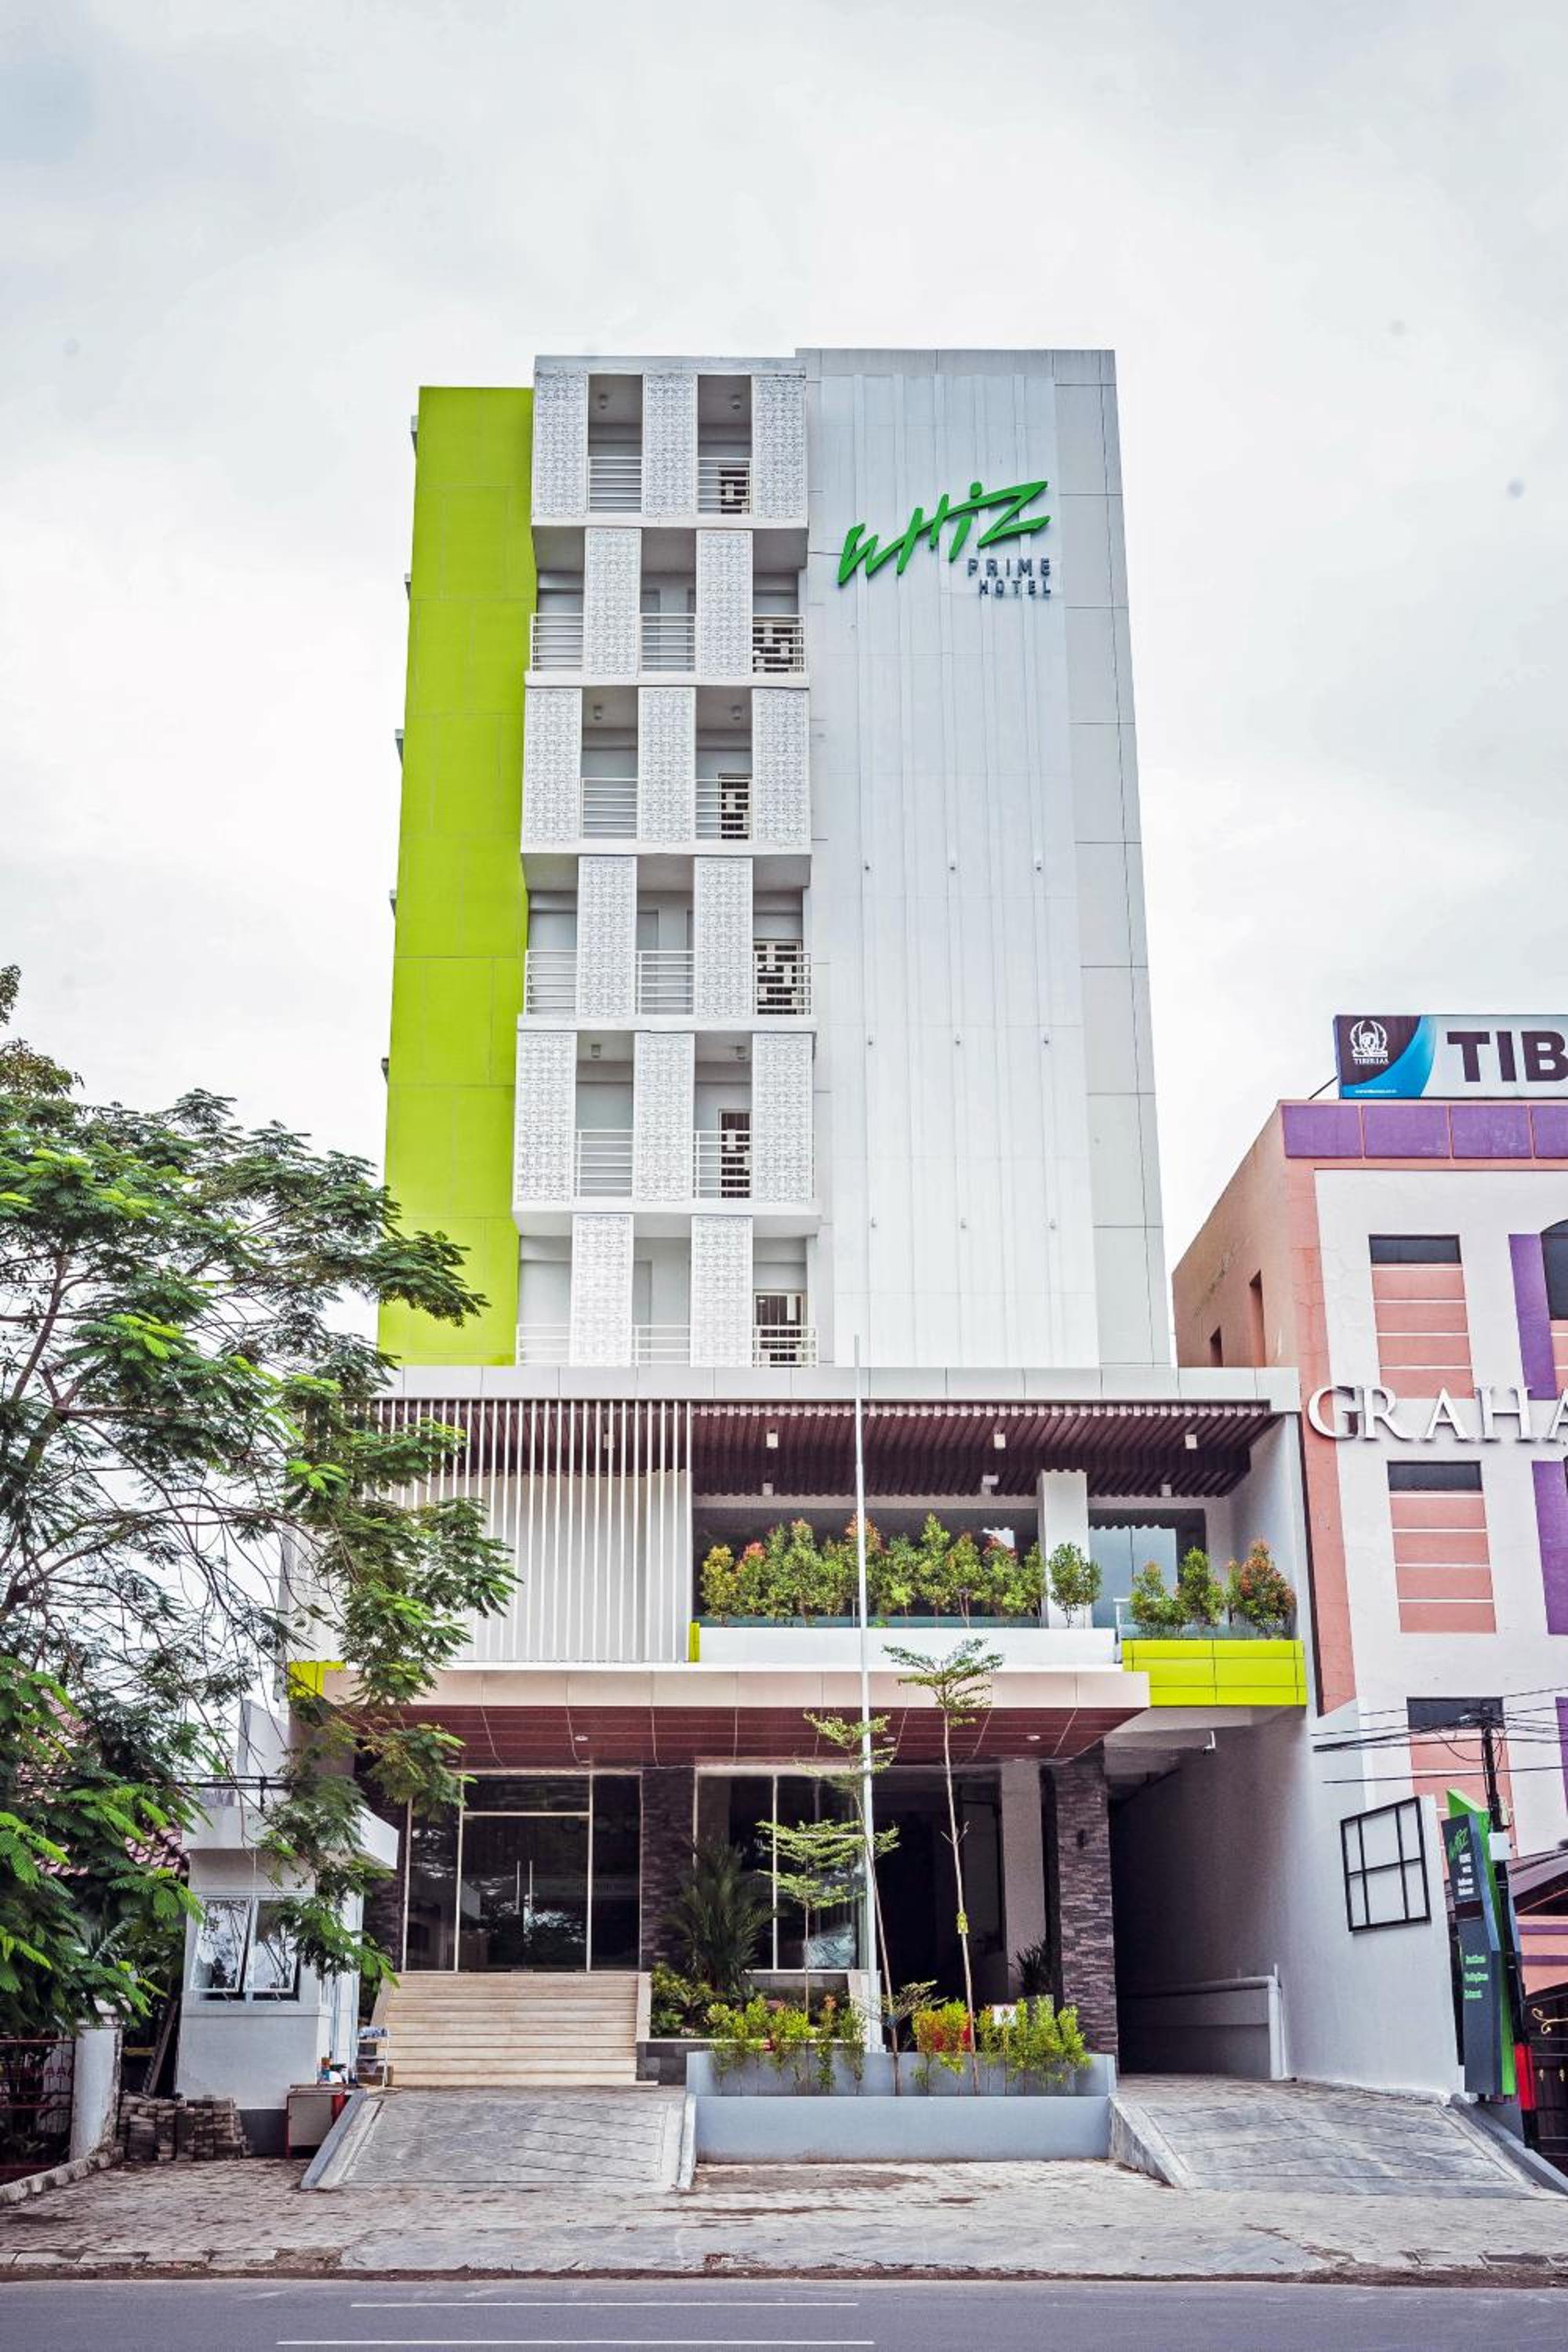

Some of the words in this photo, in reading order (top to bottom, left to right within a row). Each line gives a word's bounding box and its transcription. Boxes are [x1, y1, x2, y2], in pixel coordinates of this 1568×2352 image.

[967, 557, 1051, 577] PRIME
[978, 579, 1051, 596] HOTEL
[1446, 1031, 1568, 1082] TIB
